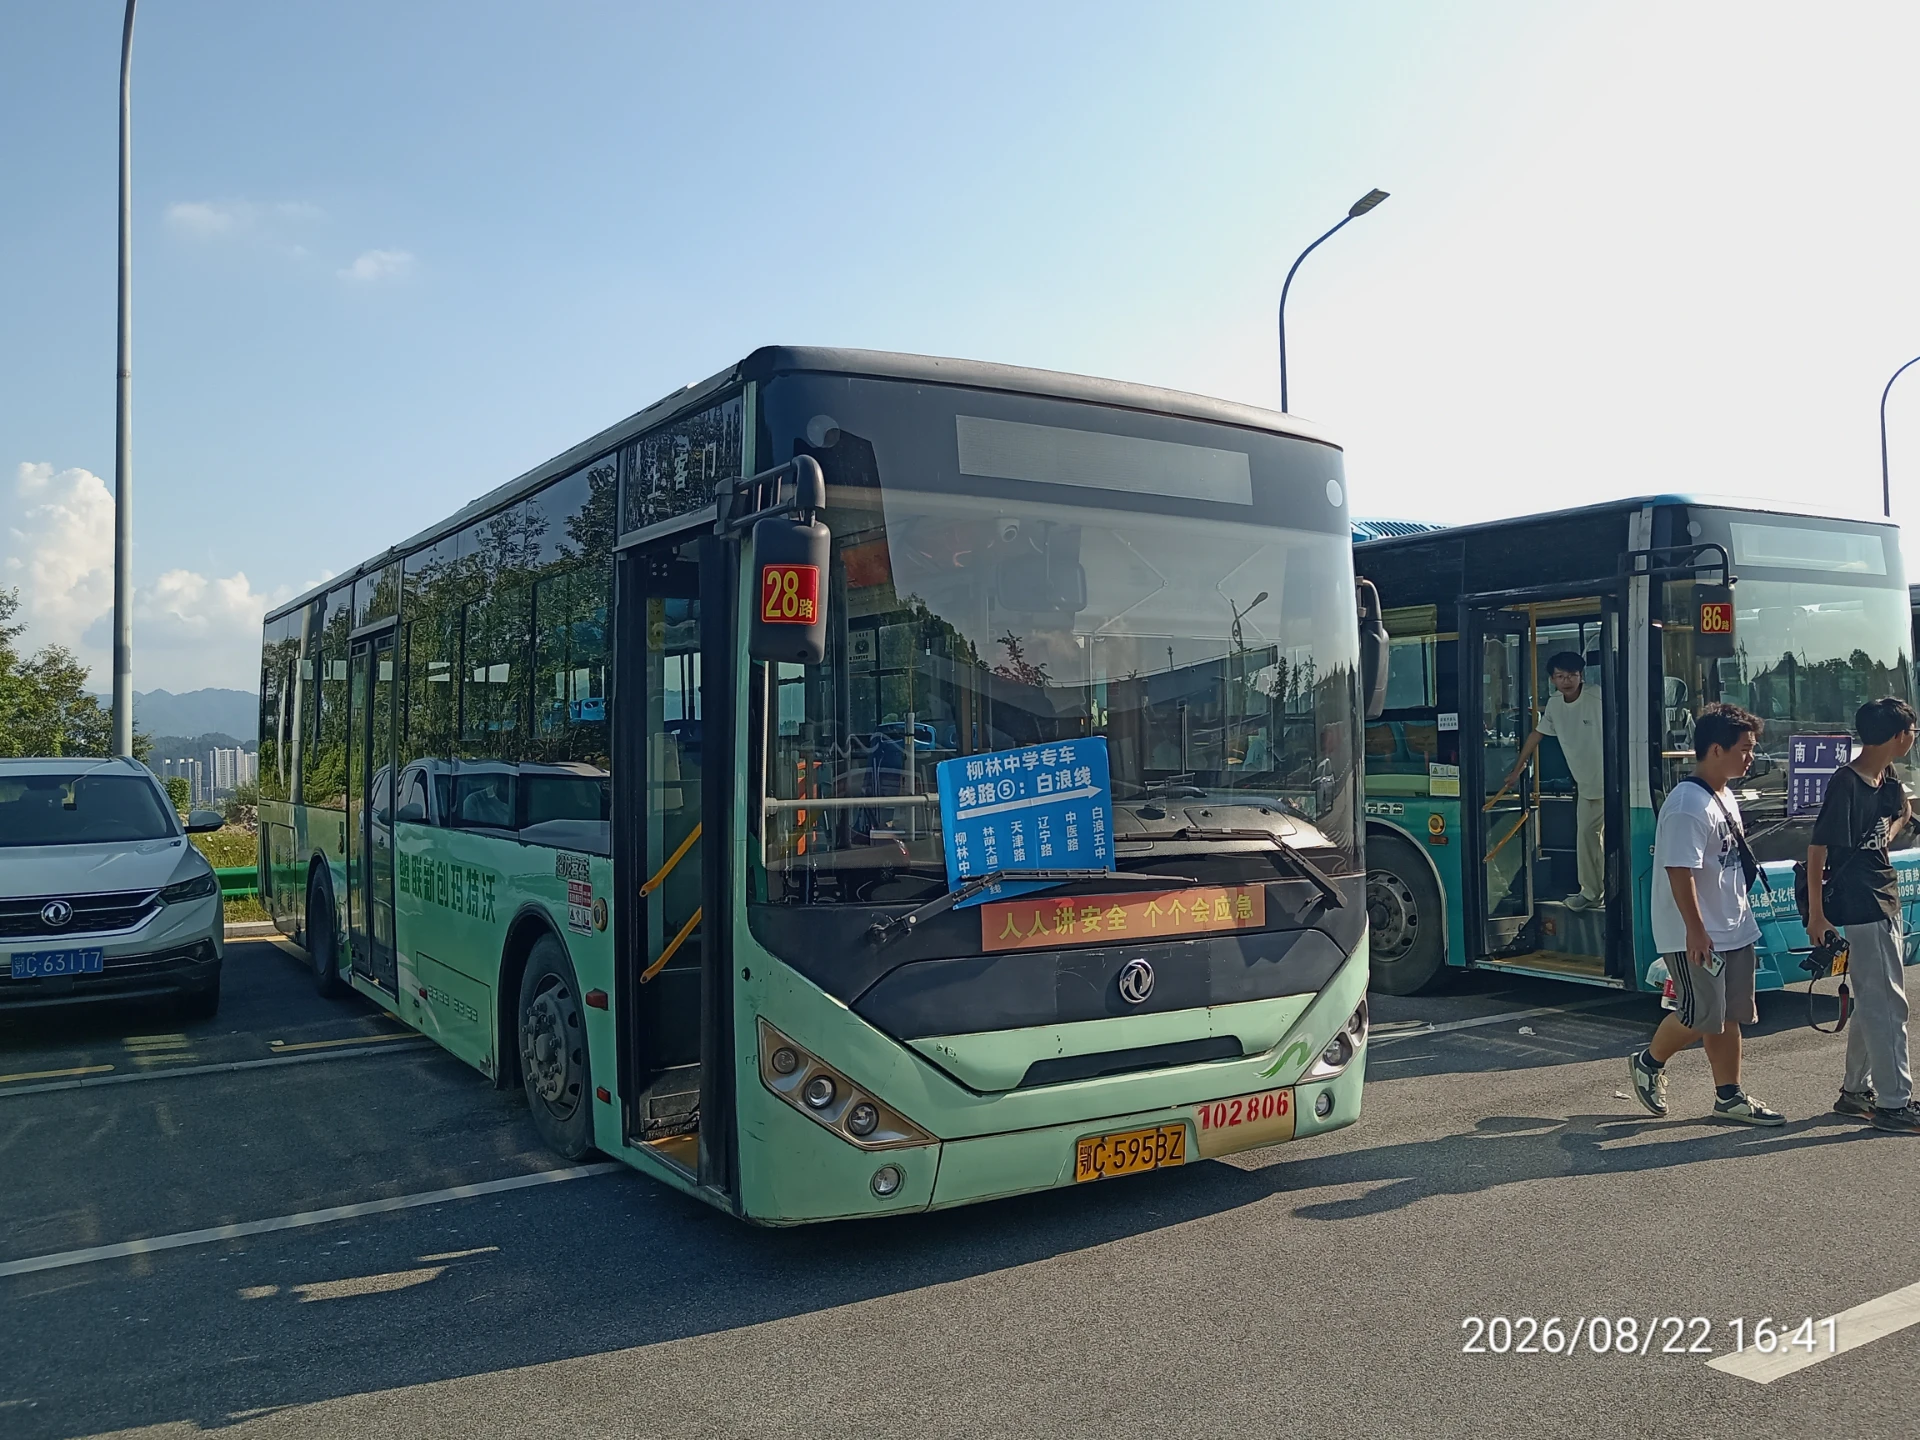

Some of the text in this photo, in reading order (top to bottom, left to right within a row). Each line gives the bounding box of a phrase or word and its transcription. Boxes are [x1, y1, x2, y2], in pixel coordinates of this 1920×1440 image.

[765, 570, 813, 618] 28路
[1703, 606, 1730, 631] 86路
[966, 745, 1076, 781] 柳林中学专车
[1794, 742, 1847, 763] 南广场
[1010, 820, 1026, 862] 天津路
[1037, 816, 1053, 857] 辽宁路
[1065, 811, 1079, 852] 中医路
[1092, 806, 1106, 860] 白浪五中
[998, 894, 1254, 940] 人人讲安全 个个会应急
[1198, 1091, 1289, 1131] 102806
